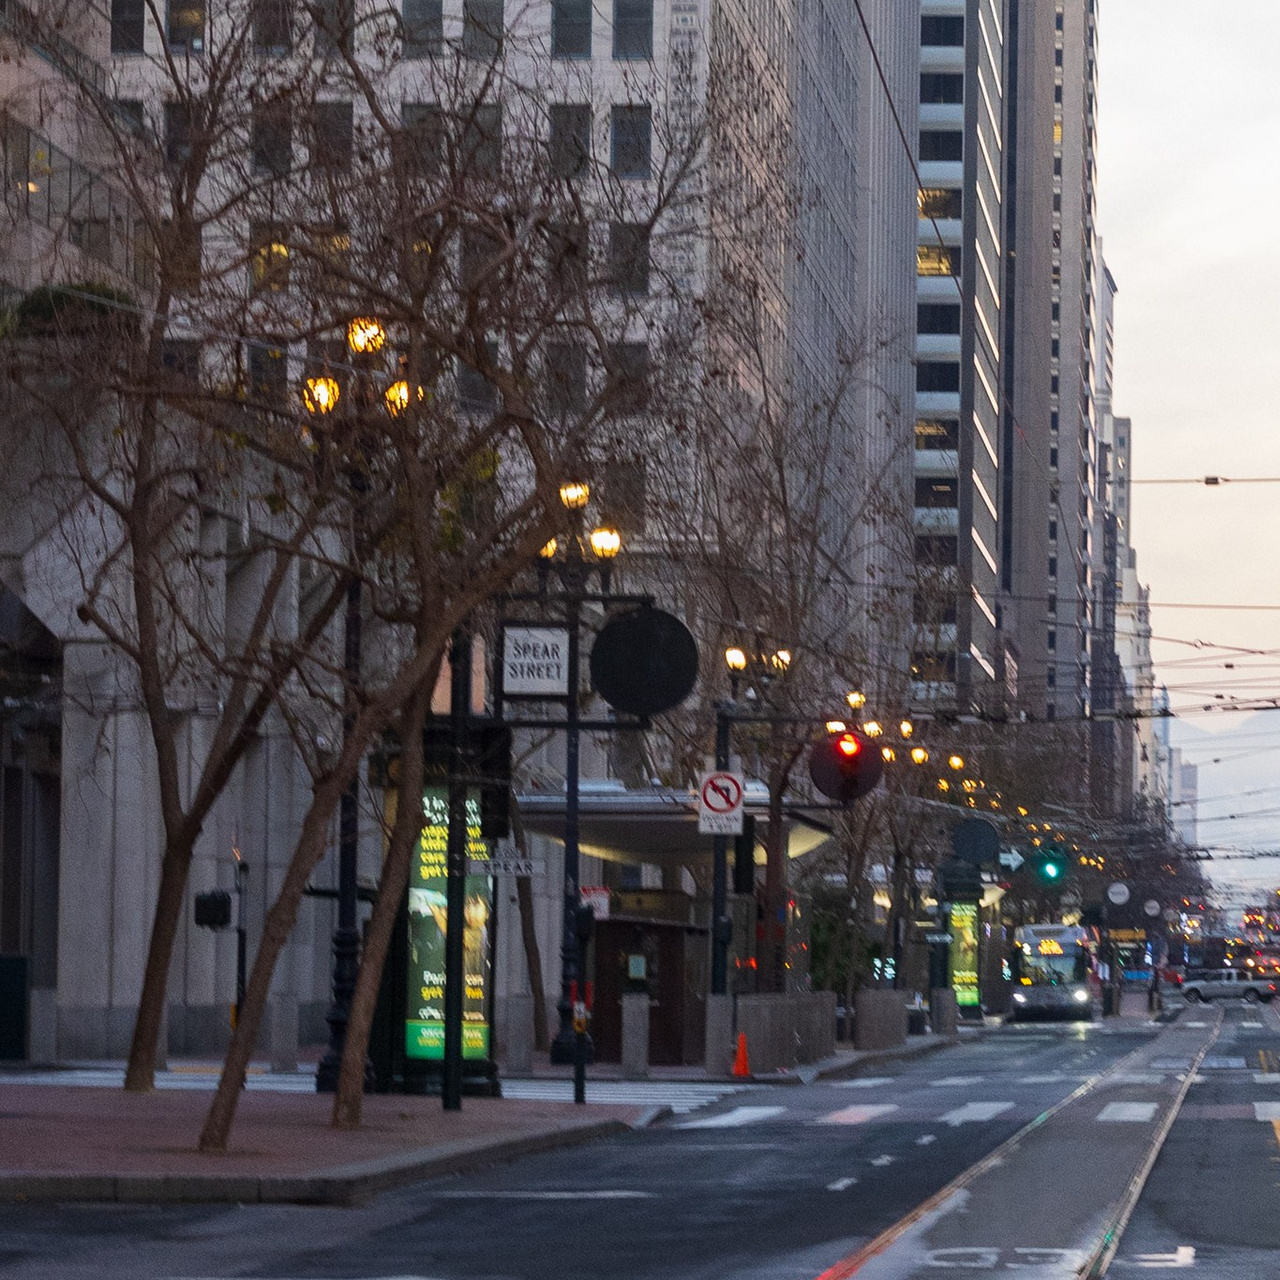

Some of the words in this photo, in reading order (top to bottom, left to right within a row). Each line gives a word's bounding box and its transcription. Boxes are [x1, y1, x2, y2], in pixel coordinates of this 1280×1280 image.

[512, 642, 560, 660] SPEAR
[508, 661, 562, 680] STREET
[482, 860, 534, 874] SPEAR
